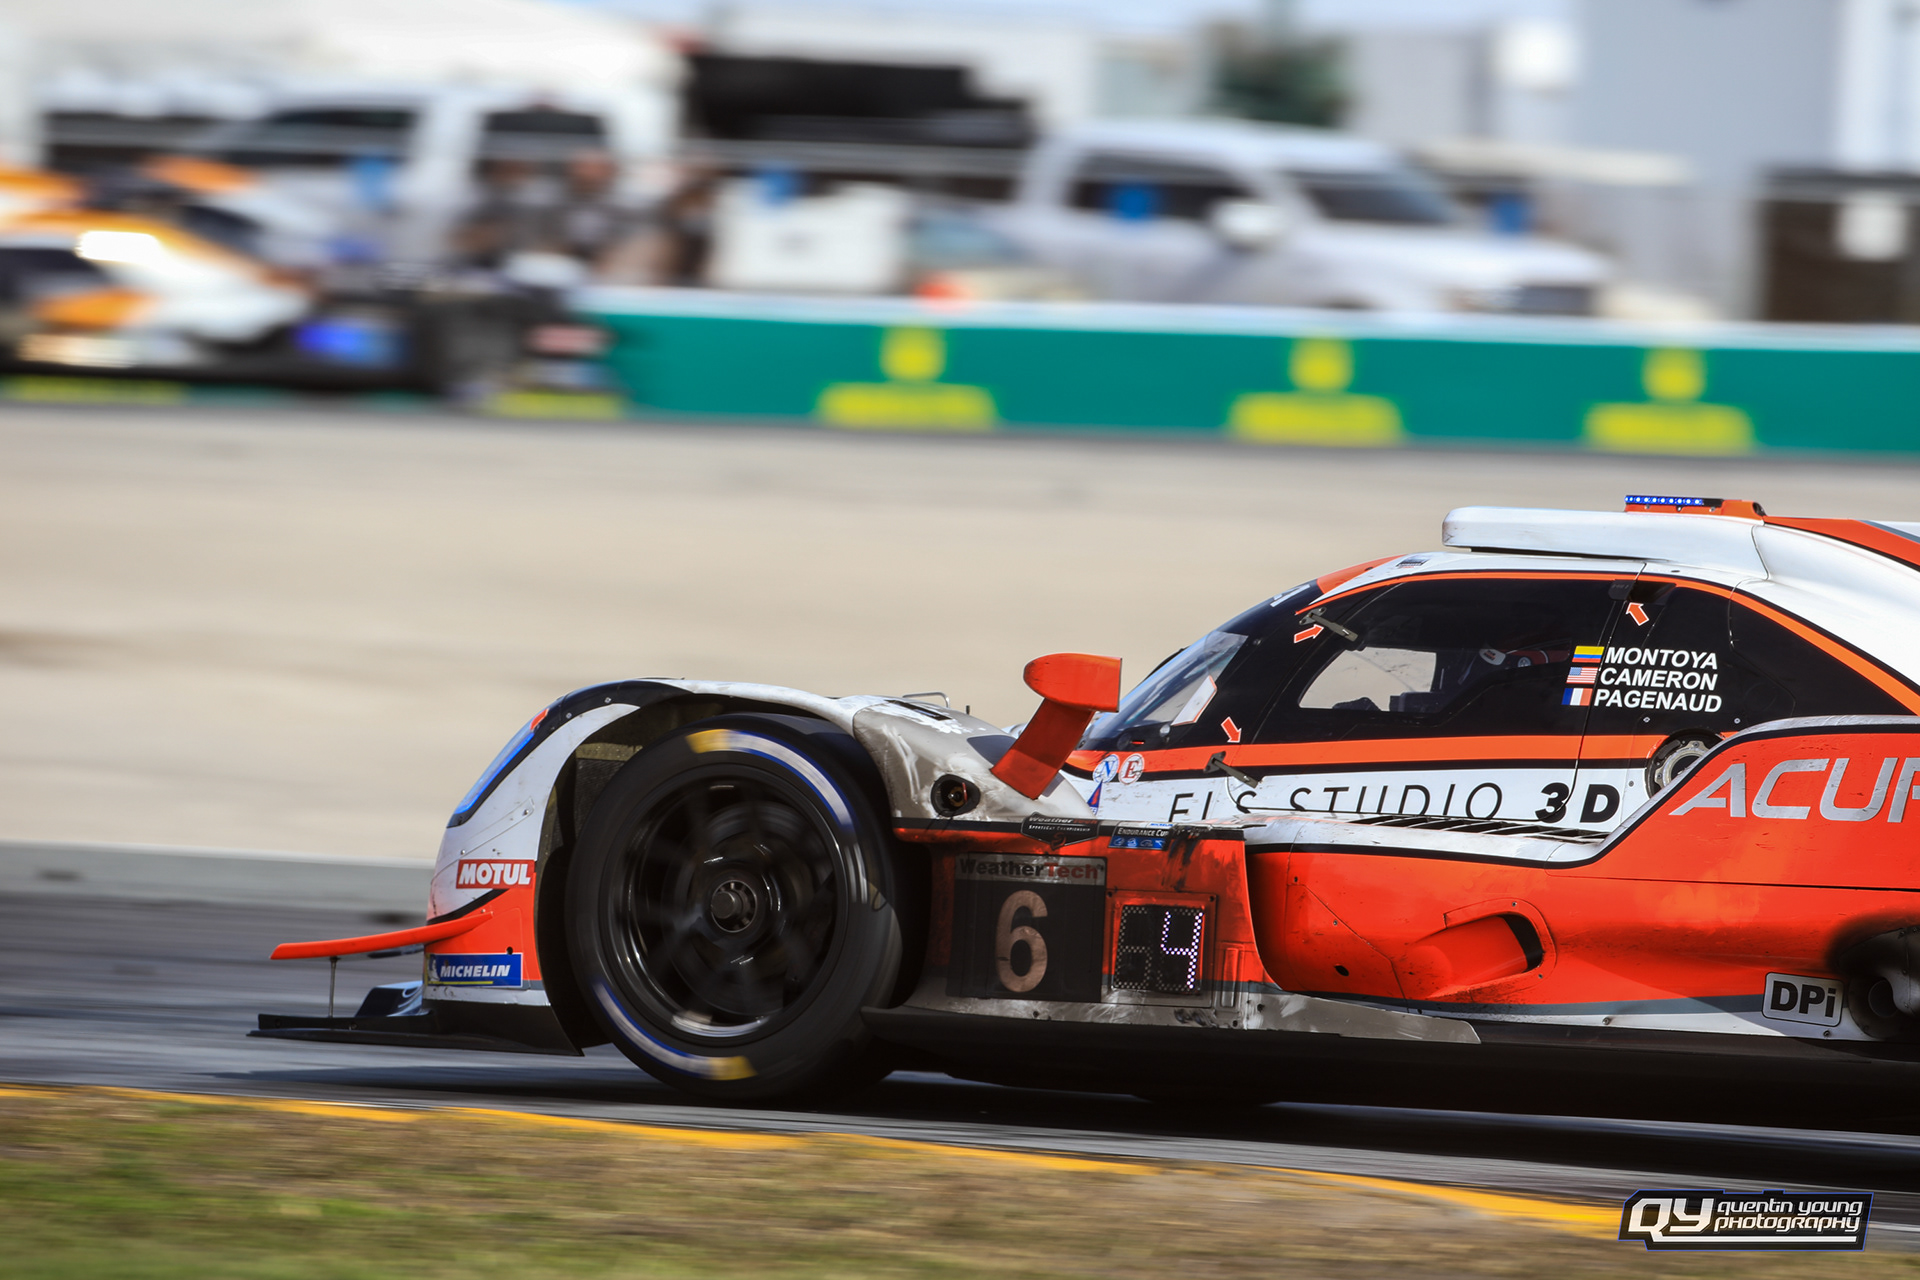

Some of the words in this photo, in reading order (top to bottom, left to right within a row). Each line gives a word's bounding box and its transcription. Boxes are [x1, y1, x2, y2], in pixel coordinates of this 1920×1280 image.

[1604, 646, 1718, 670] MONTOYA
[1600, 667, 1719, 691] CAMERON
[1593, 688, 1723, 713] PAGENAUD
[1290, 782, 1504, 820] STUDIO
[458, 862, 531, 885] MOTUL
[959, 858, 1098, 880] WeatherTech
[996, 890, 1048, 993] 6
[440, 965, 511, 977] MICHELIN
[1770, 980, 1837, 1018] DPi
